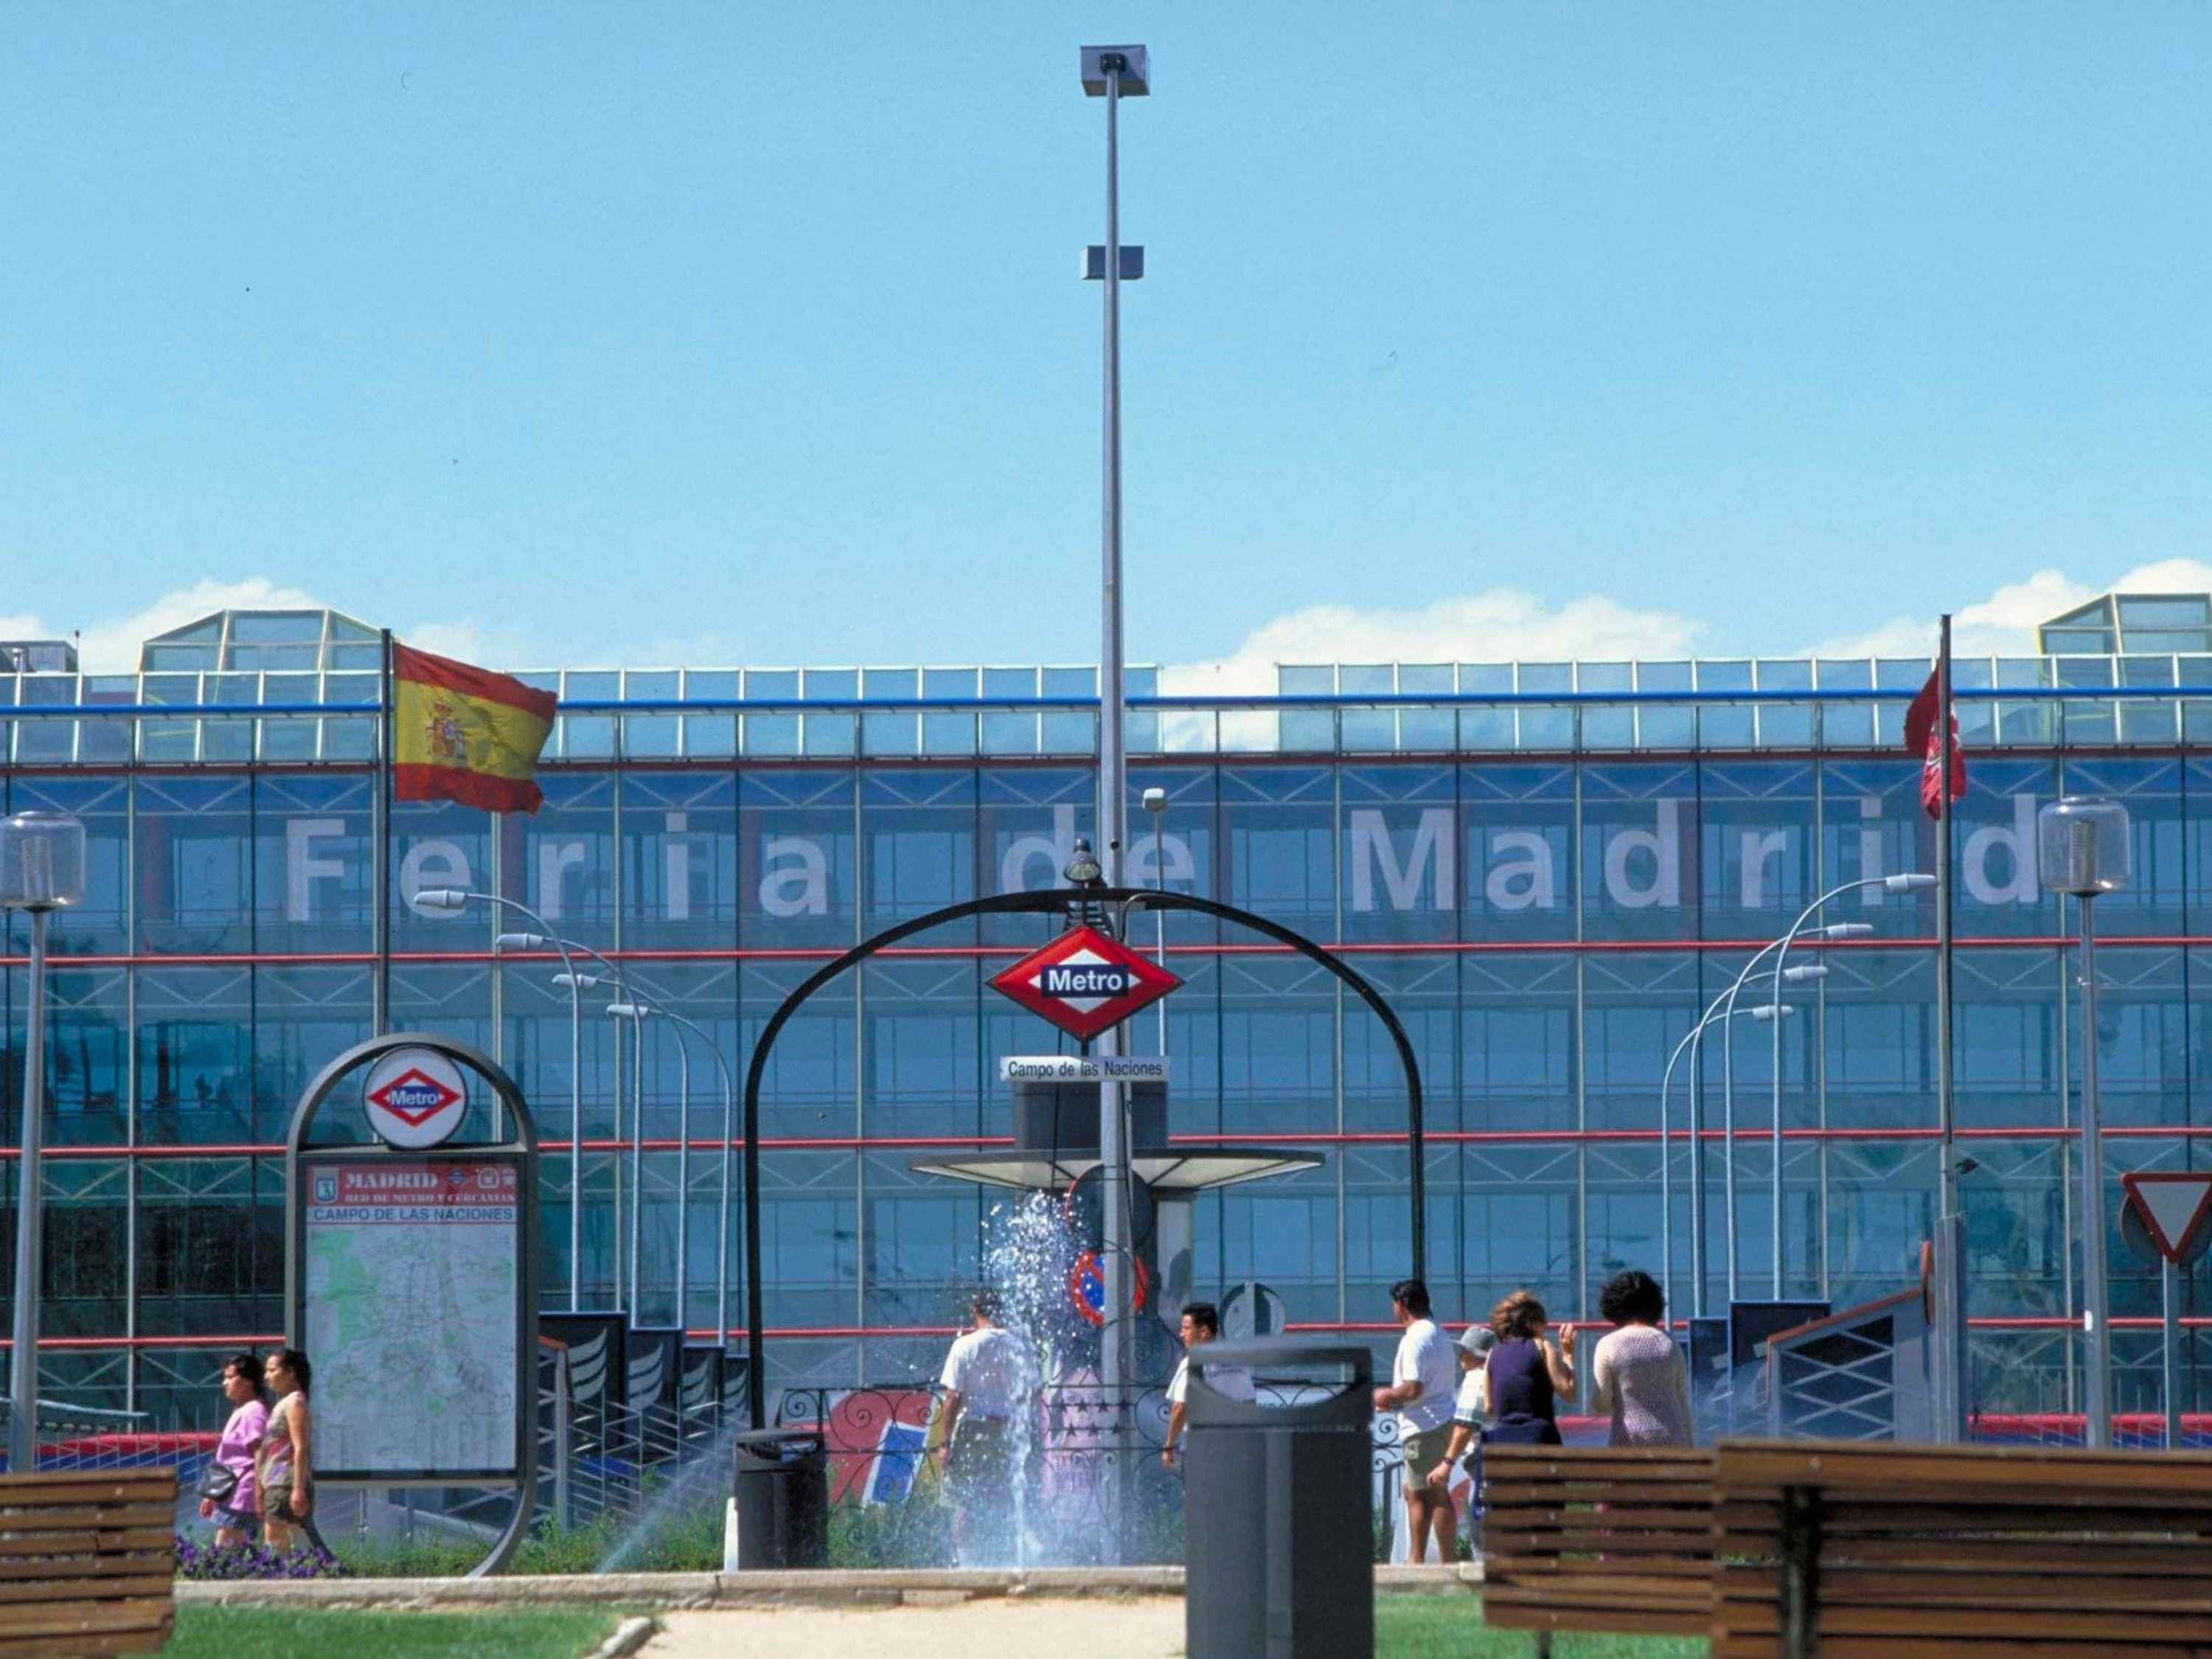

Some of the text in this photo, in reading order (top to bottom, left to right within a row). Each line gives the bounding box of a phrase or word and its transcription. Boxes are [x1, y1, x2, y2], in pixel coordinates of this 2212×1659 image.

[286, 793, 2039, 922] Feria de Madrid
[1047, 969, 1123, 992] Metro
[1008, 1060, 1163, 1078] Campo de las Naciones
[391, 1090, 437, 1106] Metro
[345, 1172, 439, 1189] MADRID
[313, 1208, 514, 1221] CAMPO DE LAS NACIONES
